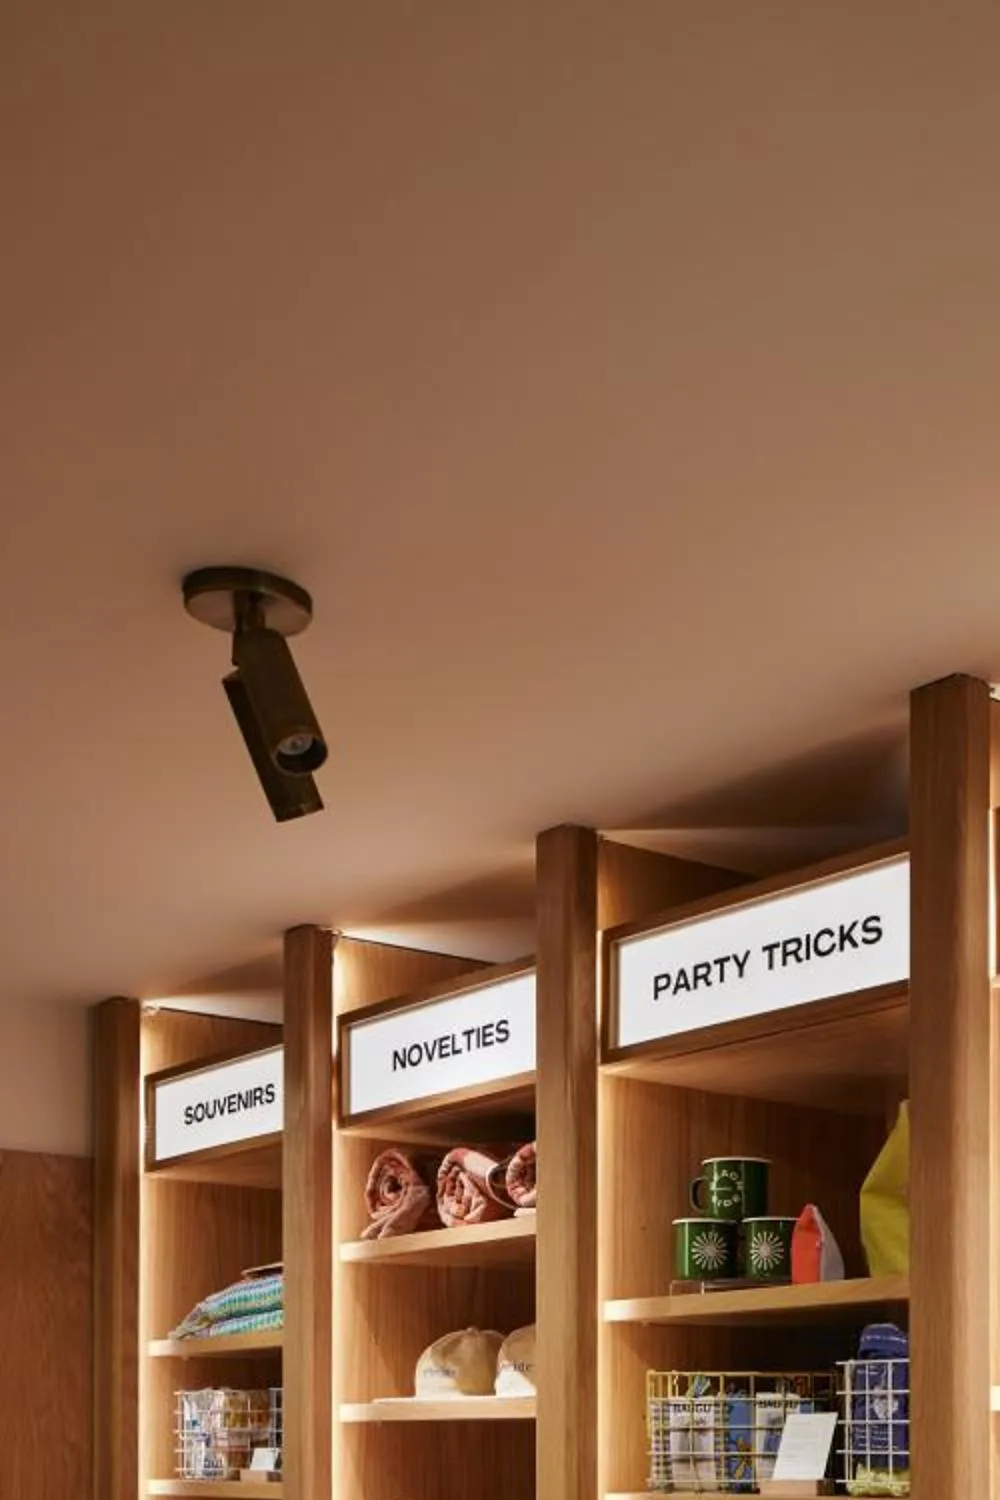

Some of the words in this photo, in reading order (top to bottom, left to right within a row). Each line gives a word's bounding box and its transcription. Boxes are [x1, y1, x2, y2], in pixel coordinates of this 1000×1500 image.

[653, 949, 751, 1001] PARTY
[761, 915, 883, 971] TRICKS
[392, 1019, 510, 1071] NOVELTIES
[184, 1083, 275, 1126] SOUVENIRS
